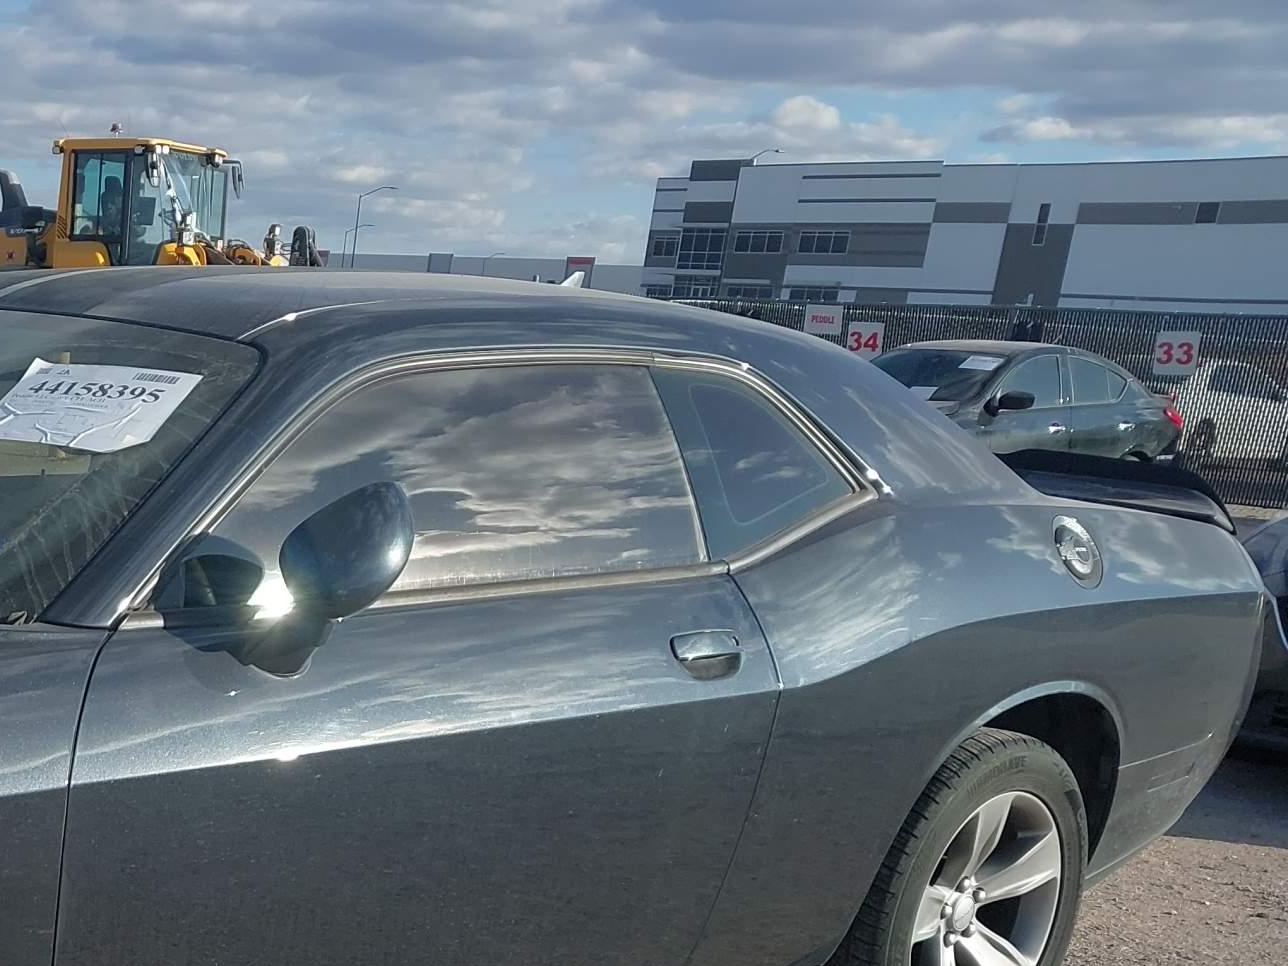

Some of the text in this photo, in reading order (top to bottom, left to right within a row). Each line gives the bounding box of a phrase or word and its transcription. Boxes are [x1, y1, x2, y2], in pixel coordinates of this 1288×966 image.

[811, 314, 835, 325] PEDDLE
[848, 331, 879, 352] 34
[1156, 342, 1194, 365] 33
[29, 380, 167, 404] 44158395
